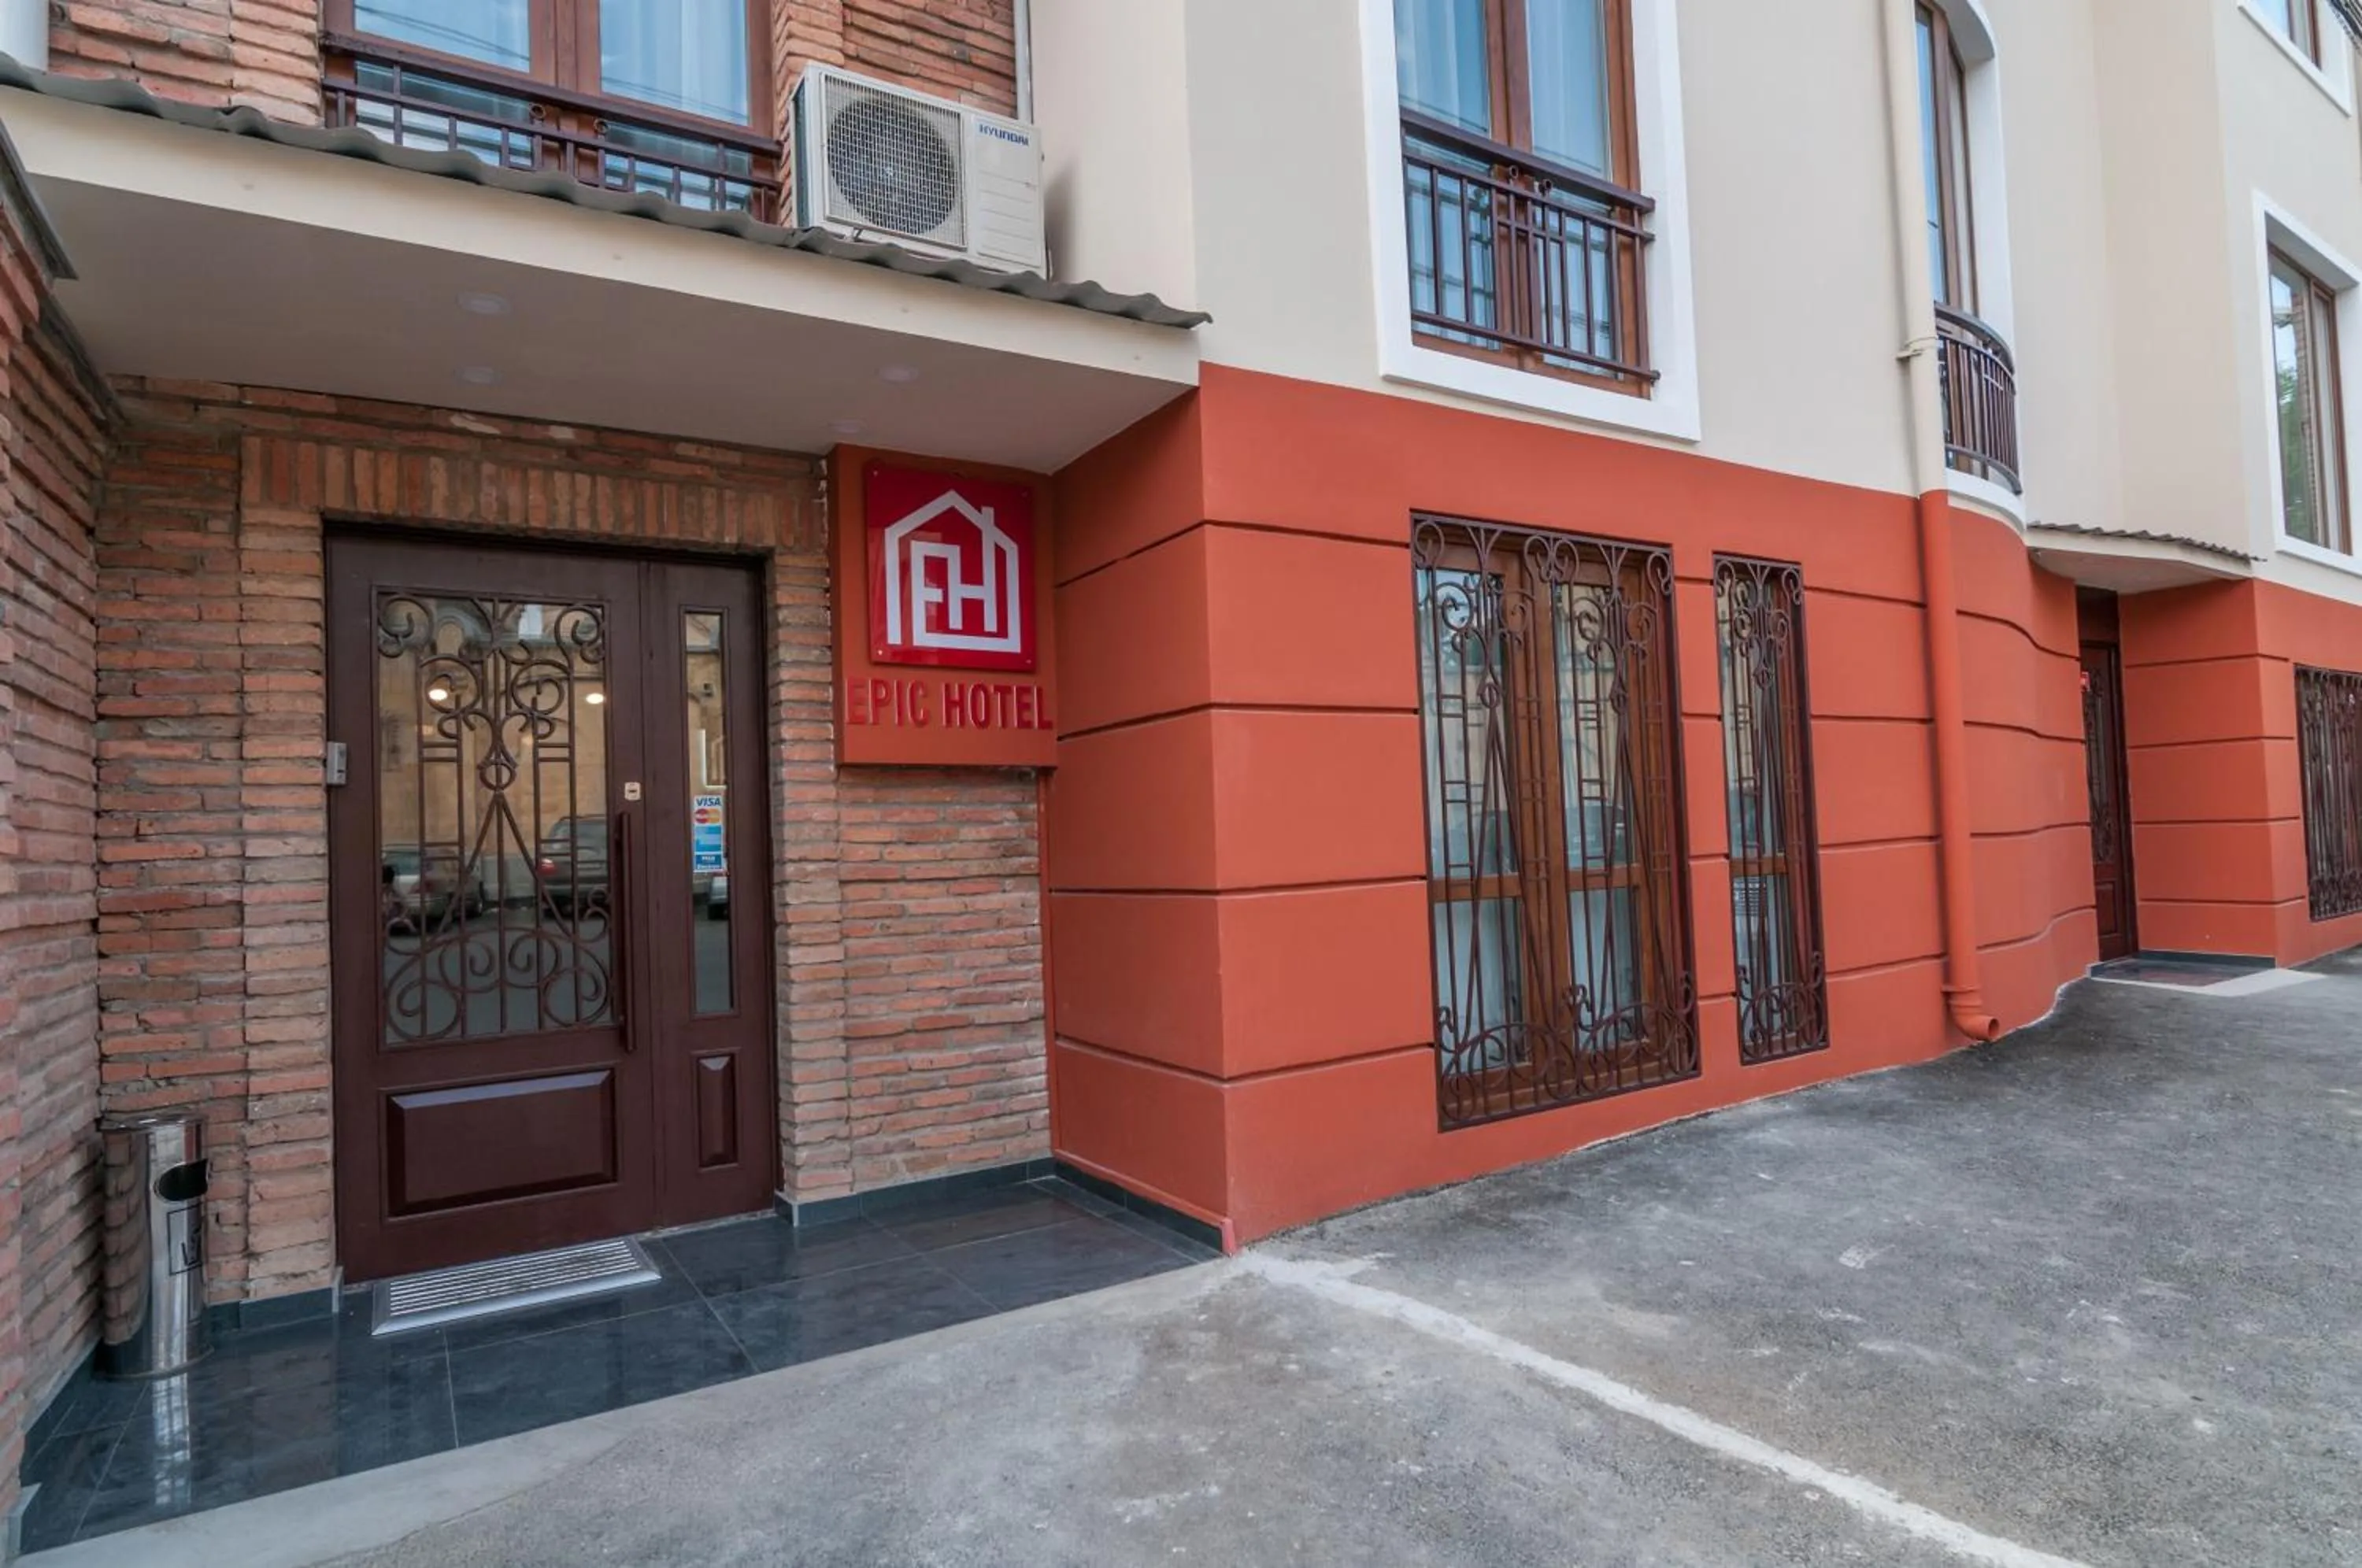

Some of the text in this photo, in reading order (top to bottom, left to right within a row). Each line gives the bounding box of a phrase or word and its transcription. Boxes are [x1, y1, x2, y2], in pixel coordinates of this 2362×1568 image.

[979, 124, 1029, 146] HYUNDAI
[845, 677, 1054, 731] EPIC HOTEL
[696, 797, 722, 807] VISA
